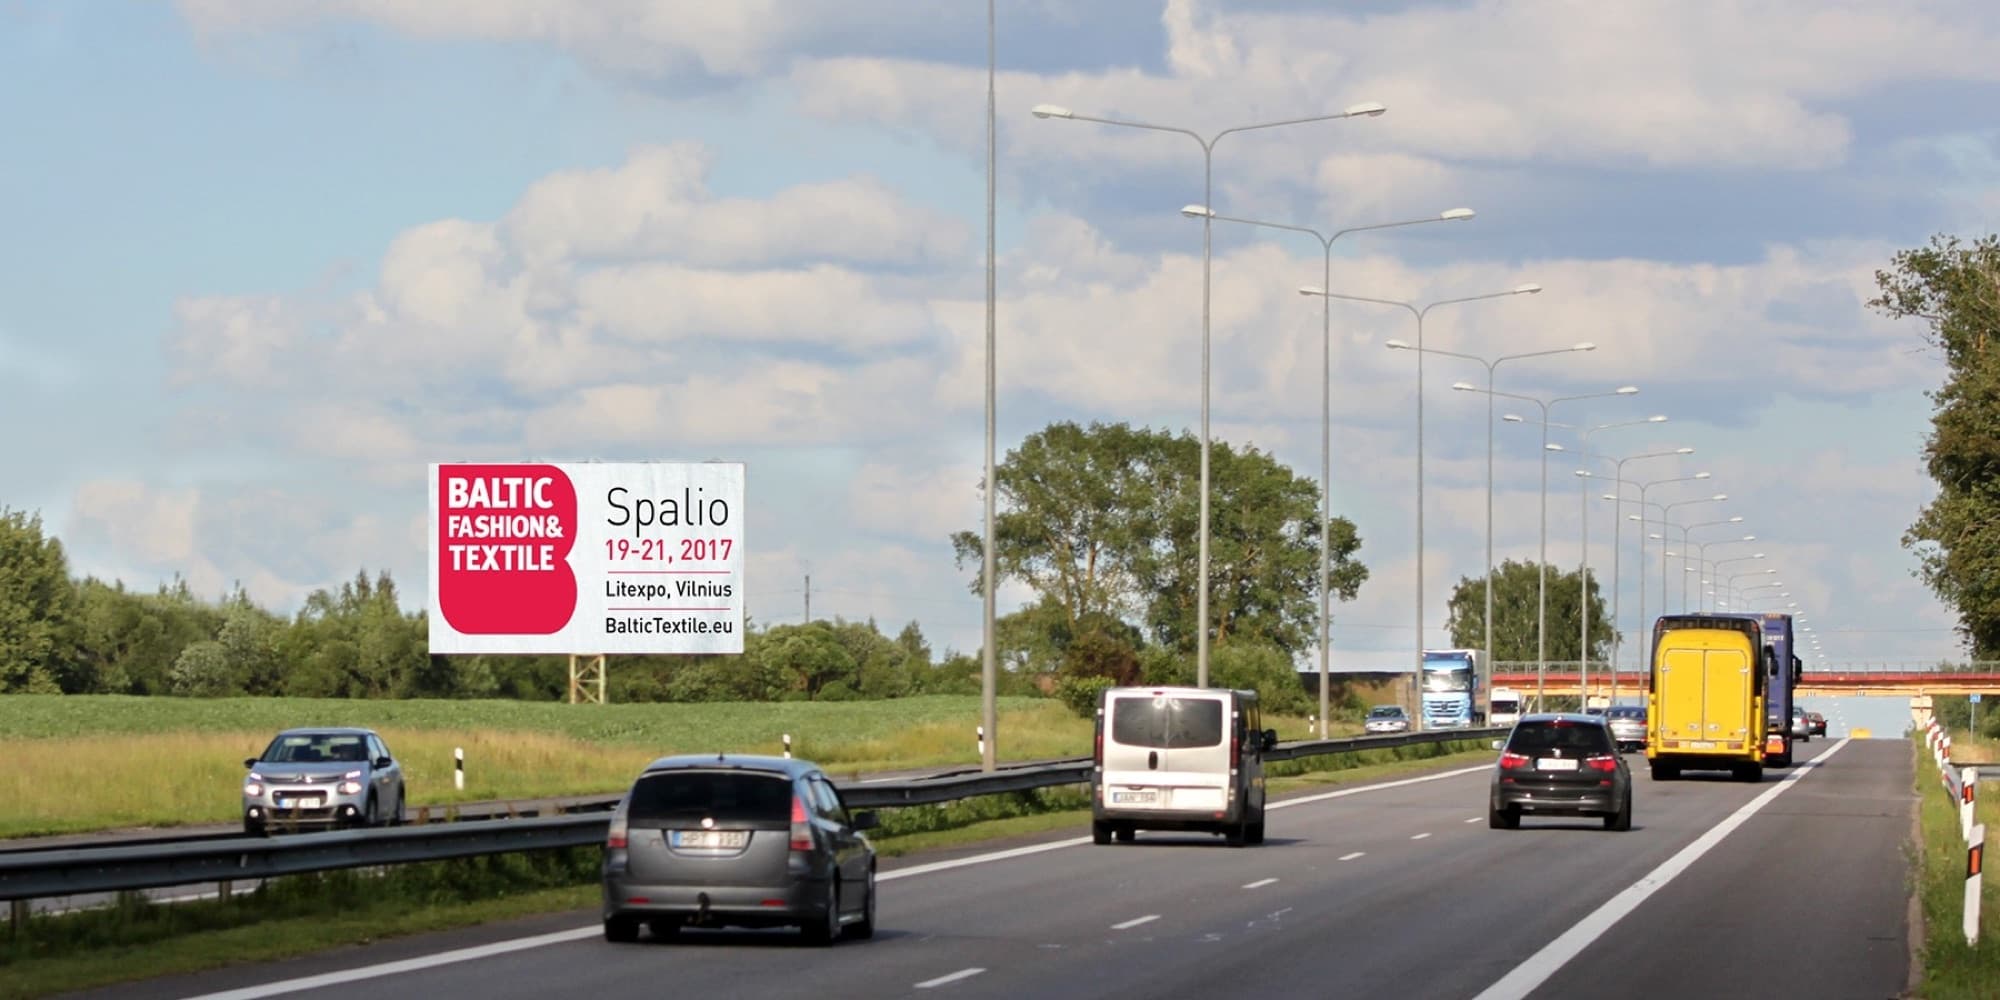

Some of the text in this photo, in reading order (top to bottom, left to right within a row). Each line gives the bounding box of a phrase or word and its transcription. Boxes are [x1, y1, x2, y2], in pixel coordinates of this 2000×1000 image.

[449, 477, 553, 508] BALTIC
[607, 486, 729, 537] Spalio
[449, 515, 563, 538] FASHION&
[449, 545, 554, 571] TEXTILE
[605, 539, 732, 564] 19-21, 2017
[606, 581, 732, 600] Litexpo, Vilnius
[606, 618, 732, 634] BalticTextile.eu
